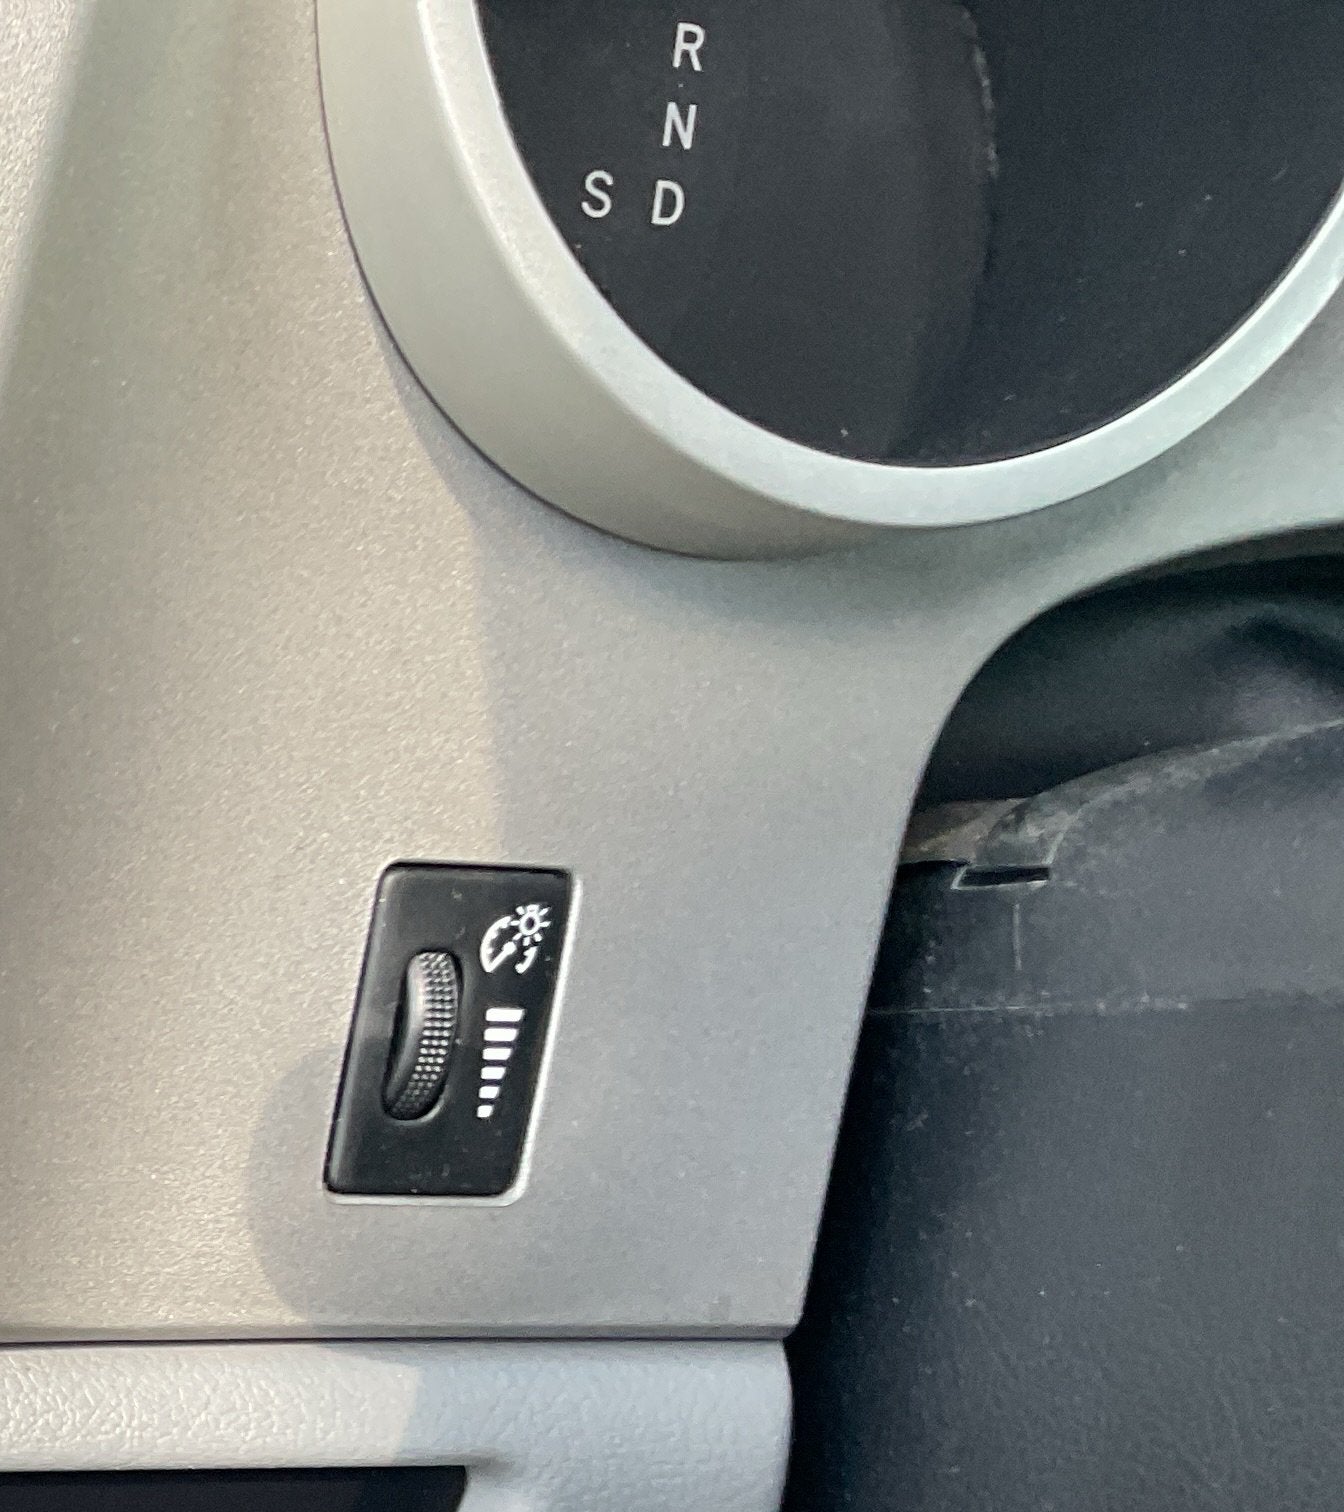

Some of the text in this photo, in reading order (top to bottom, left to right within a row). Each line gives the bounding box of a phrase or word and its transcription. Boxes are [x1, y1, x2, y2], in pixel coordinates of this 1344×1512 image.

[672, 22, 707, 72] R
[661, 101, 699, 151] N
[581, 169, 686, 227] S D
